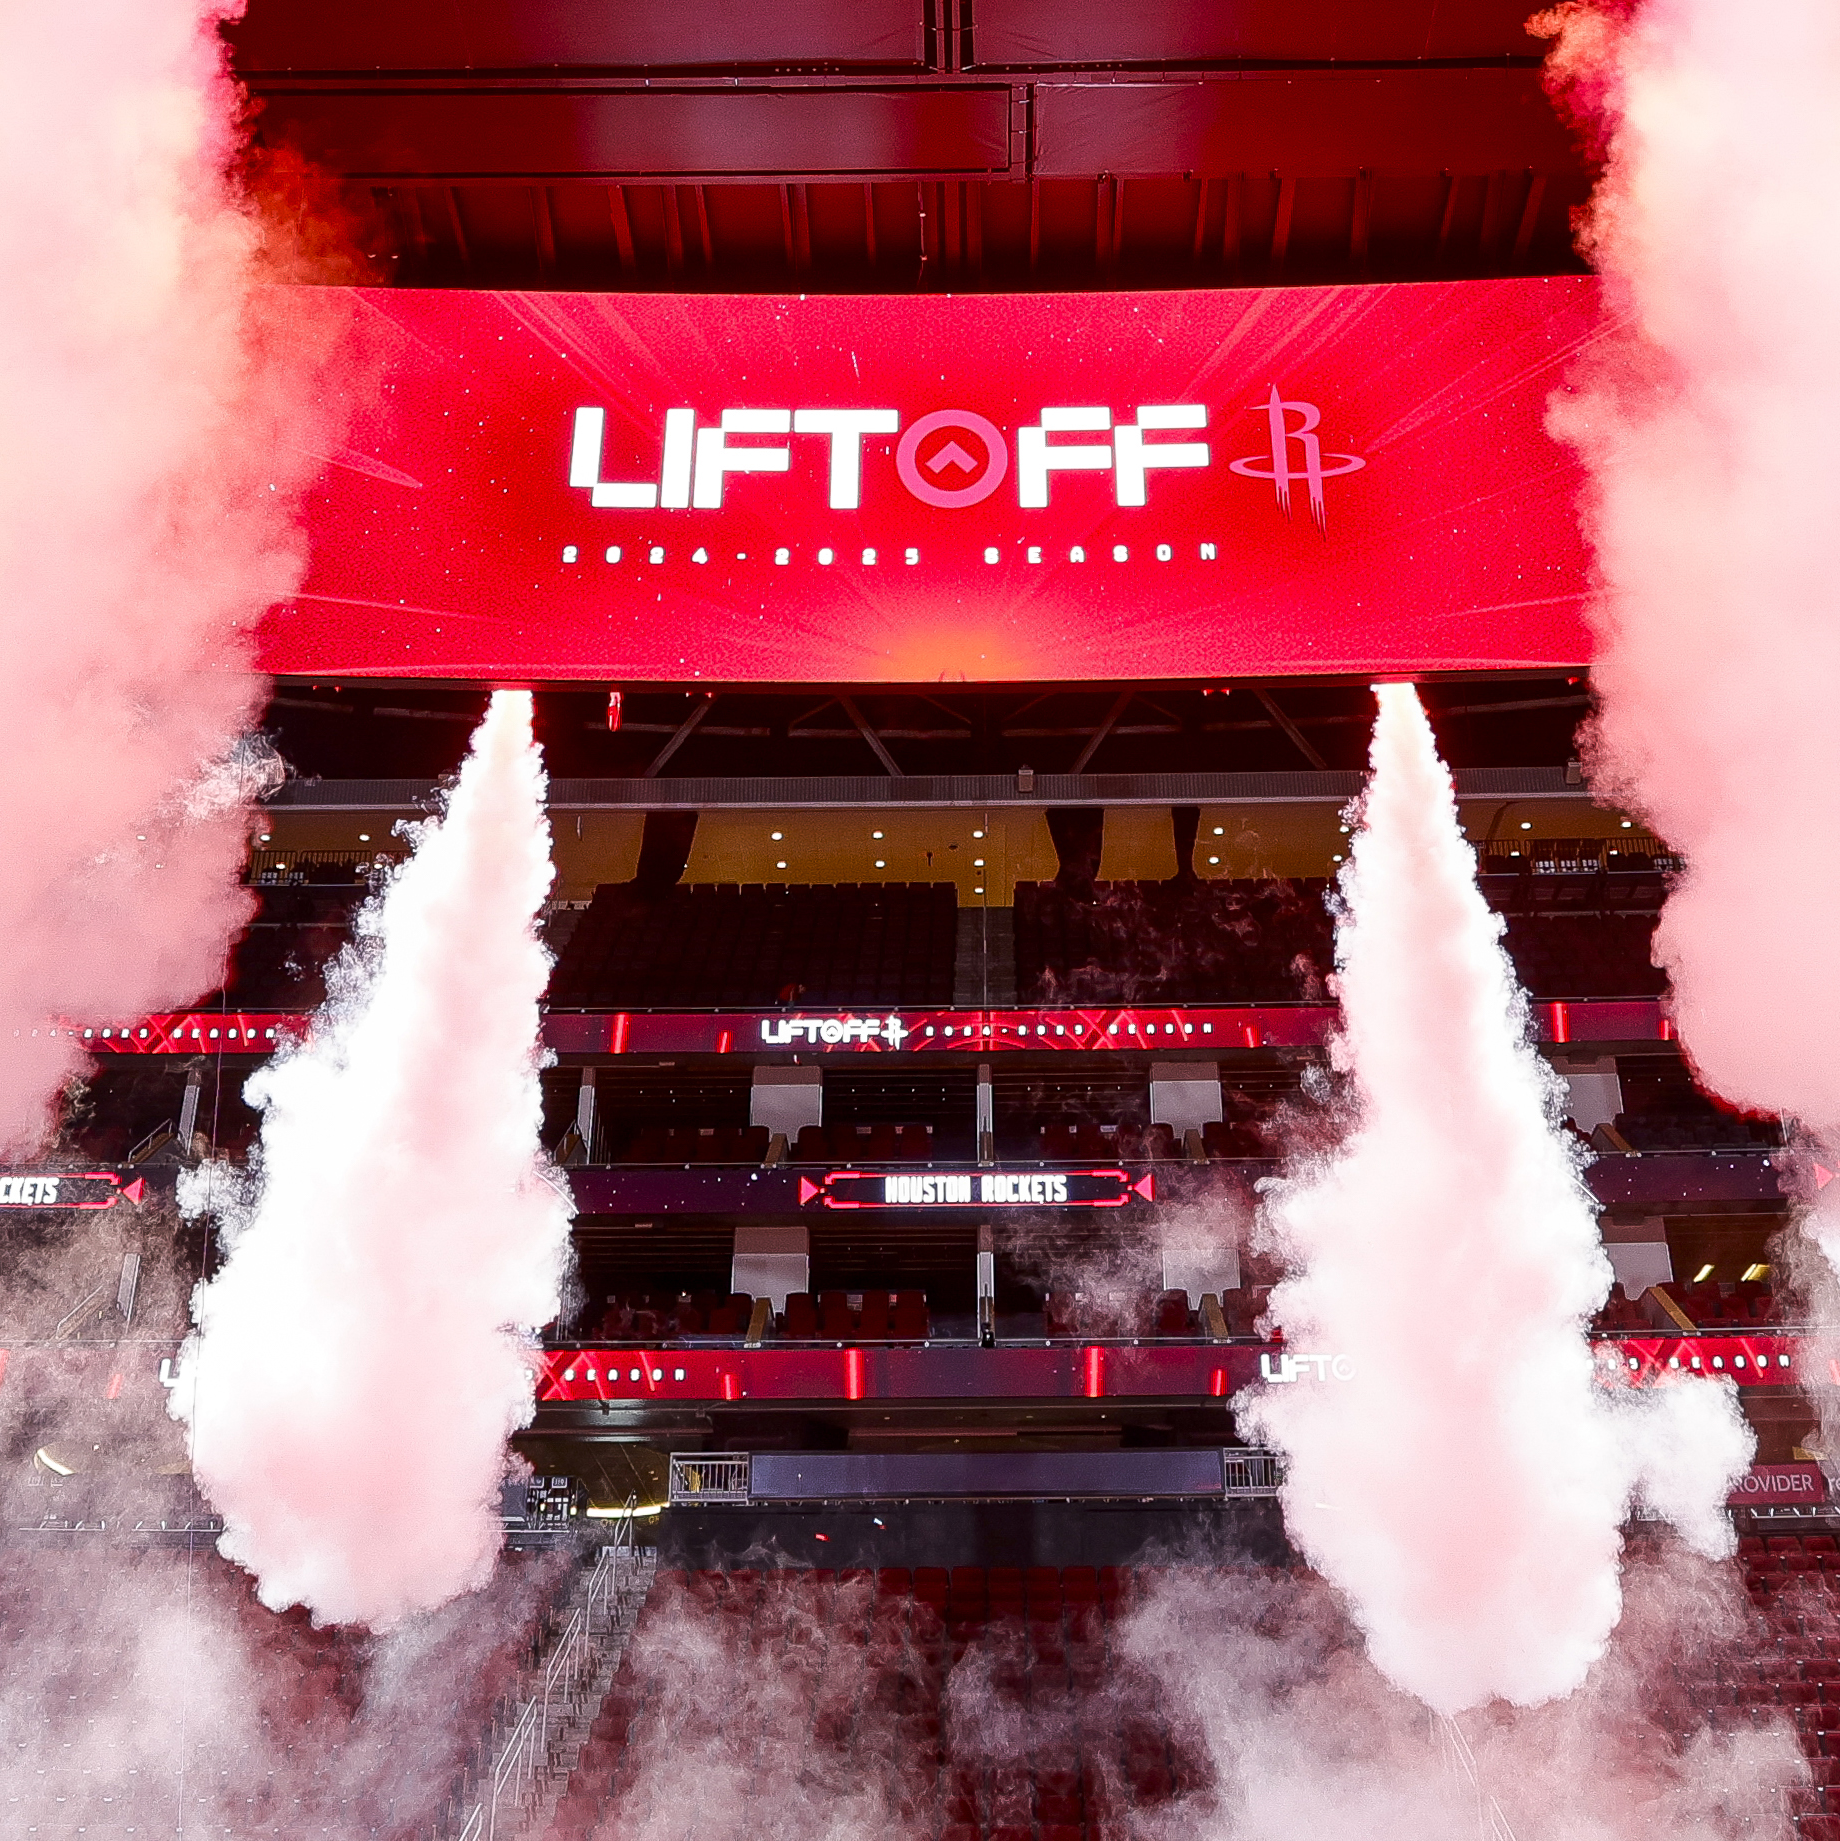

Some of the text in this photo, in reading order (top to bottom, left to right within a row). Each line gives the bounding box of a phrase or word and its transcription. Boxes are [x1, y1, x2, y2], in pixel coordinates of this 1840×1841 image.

[568, 404, 1210, 509] LIFTOFF
[761, 1018, 881, 1045] LIFTOFF
[885, 1174, 1068, 1204] HOUSTON ROCKETS
[1731, 1474, 1815, 1494] ROVIDER
